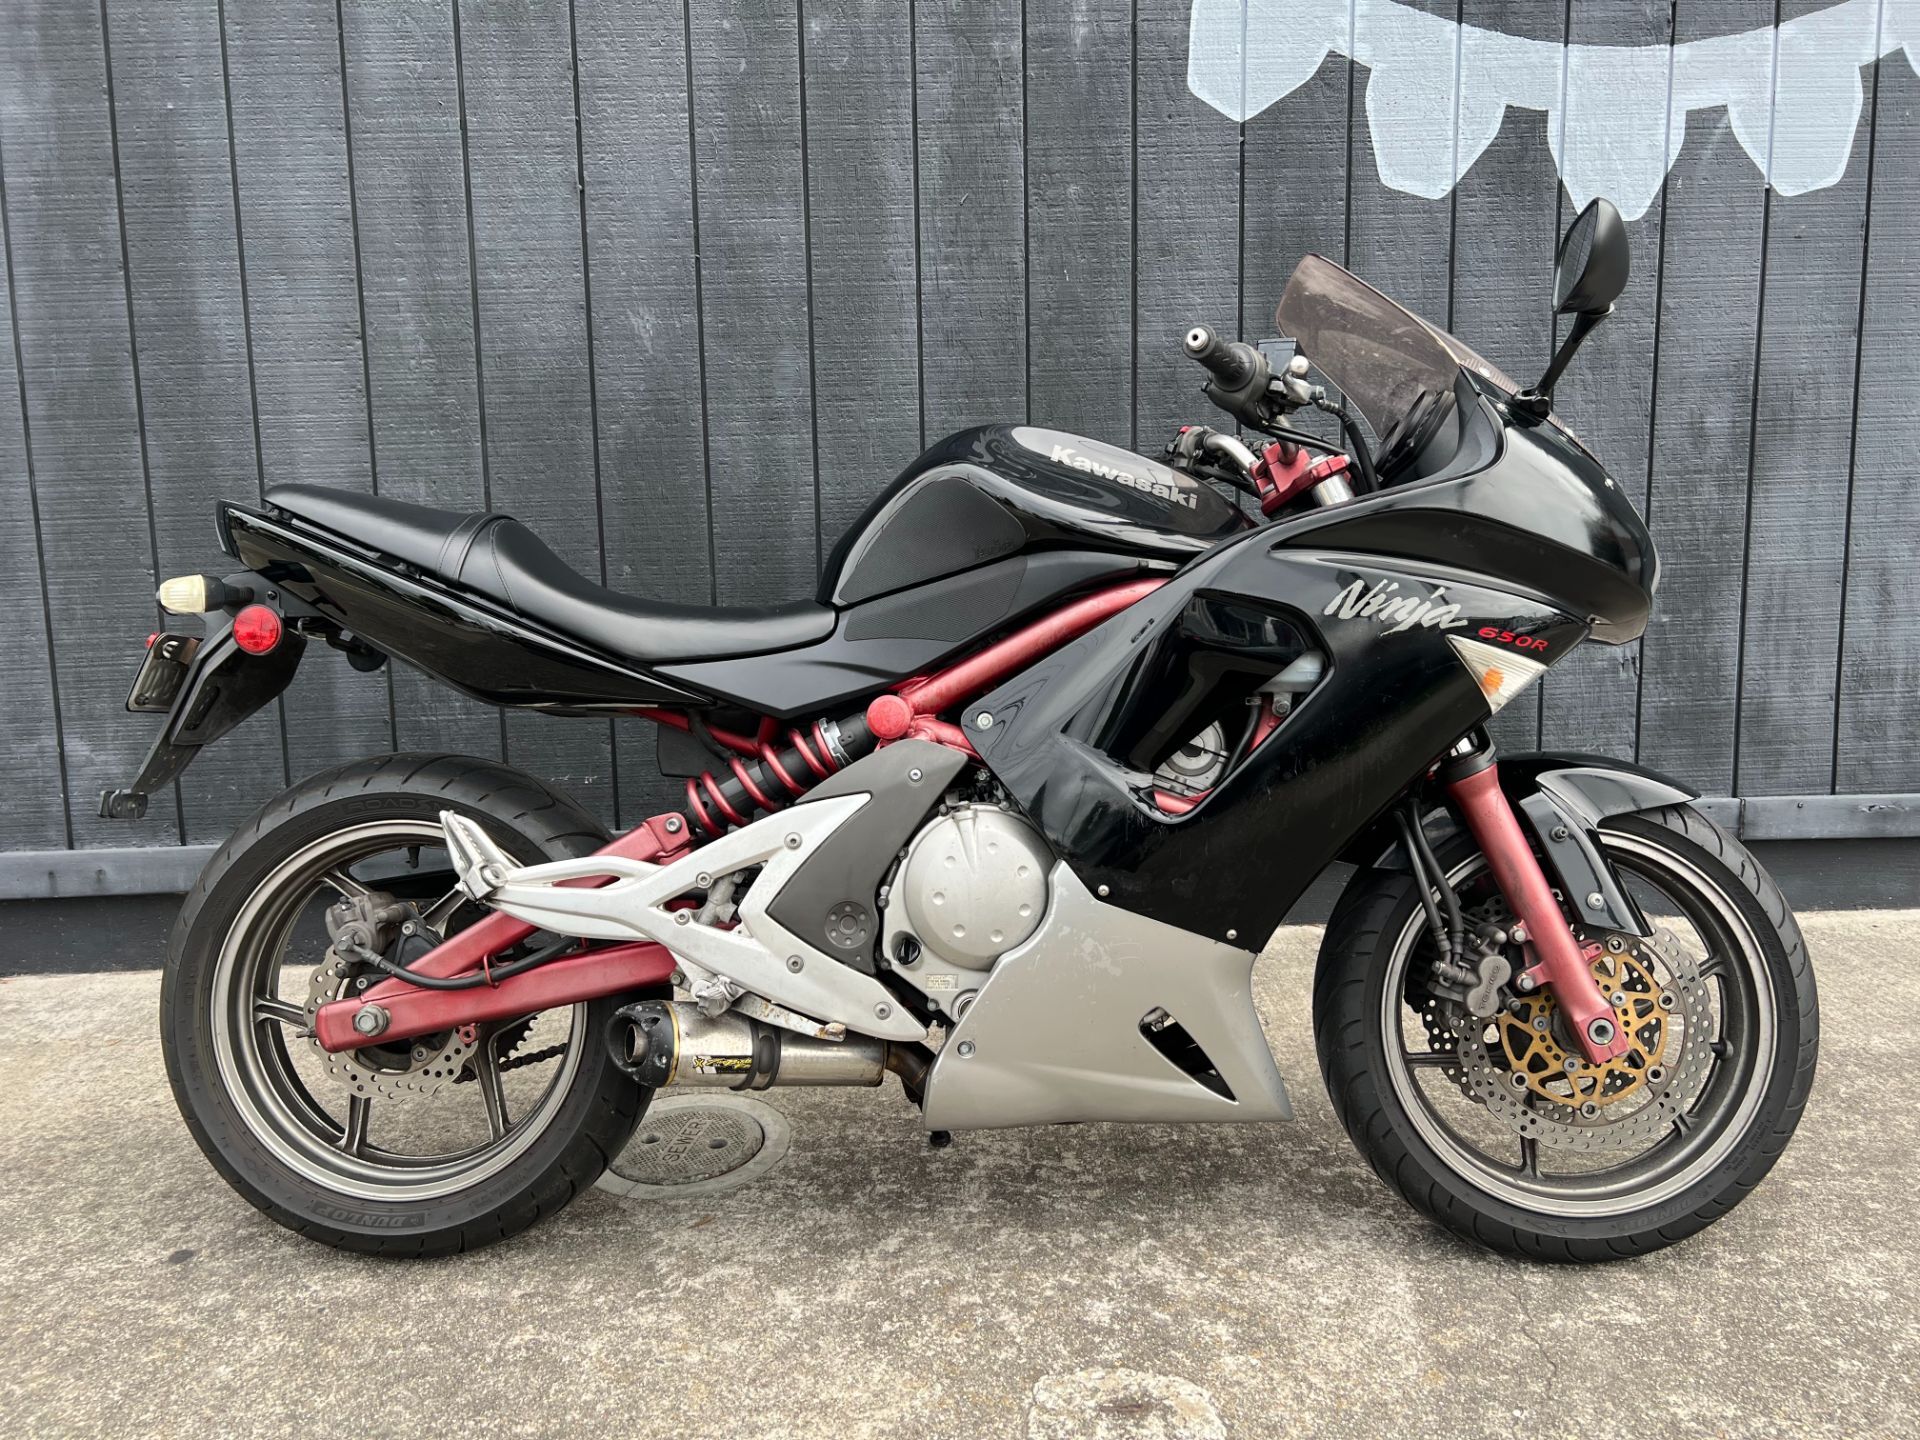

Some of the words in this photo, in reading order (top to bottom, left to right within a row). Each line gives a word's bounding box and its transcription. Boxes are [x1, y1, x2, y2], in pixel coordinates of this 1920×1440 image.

[1050, 445, 1198, 510] Kawasaki
[1323, 579, 1468, 638] Ninja
[1478, 627, 1550, 652] 650R
[662, 1121, 708, 1161] SEWER
[316, 1204, 408, 1227] DUNLOP
